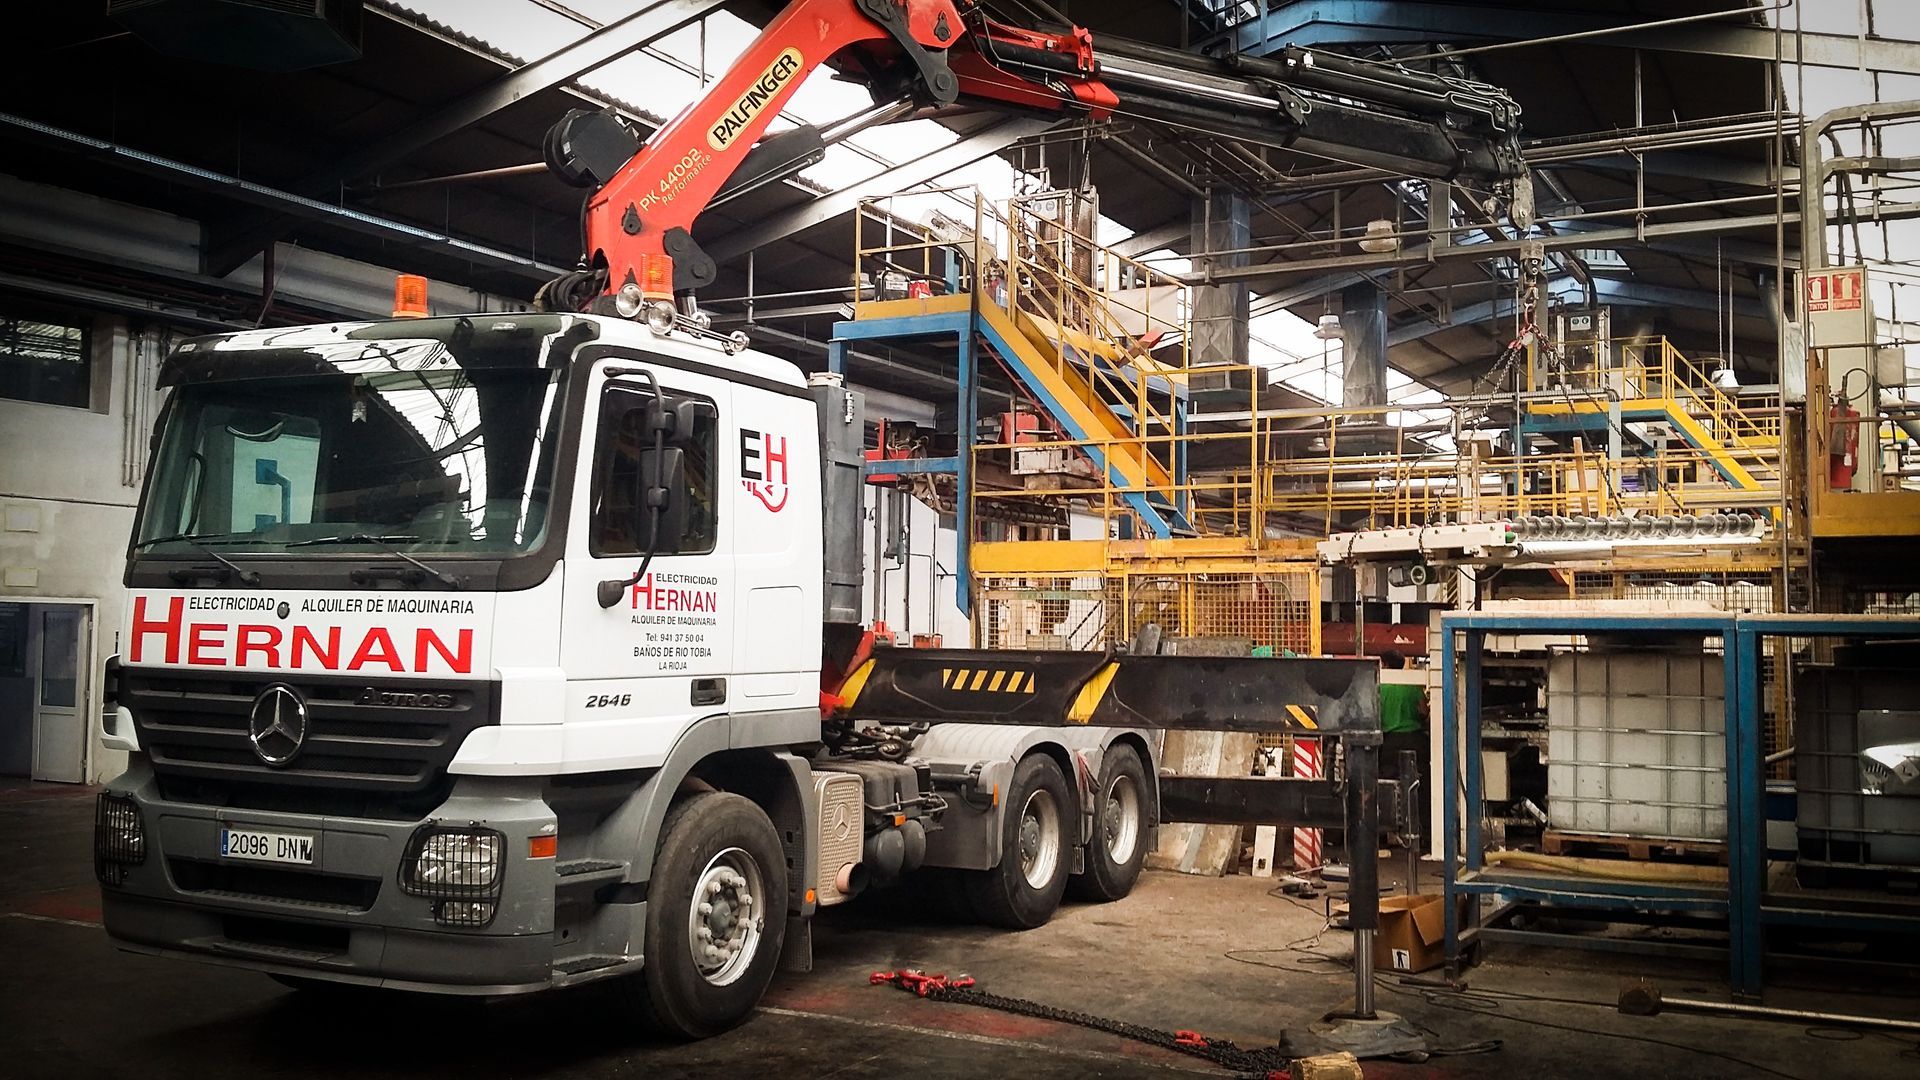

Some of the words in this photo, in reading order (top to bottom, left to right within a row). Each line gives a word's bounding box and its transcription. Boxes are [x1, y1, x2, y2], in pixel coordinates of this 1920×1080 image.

[712, 54, 798, 145] PALFINGER
[640, 189, 660, 211] PK
[660, 148, 702, 193] 44002
[740, 427, 788, 485] EH
[656, 573, 718, 586] ELECTRICIDAD
[632, 571, 717, 613] HERNAN
[189, 597, 275, 611] ELECTRICIDAD
[301, 599, 363, 613] ALQUILER
[366, 599, 384, 613] DE
[387, 599, 474, 614] MAQUINARIA
[631, 615, 666, 625] ALQUILER
[667, 616, 676, 625] DE
[678, 616, 717, 626] MAQUINARIA
[129, 596, 474, 674] HERNAN
[660, 633, 673, 642] 941
[675, 634, 684, 642] 37
[685, 634, 695, 643] 50
[696, 634, 704, 643] 04
[634, 645, 662, 657] BAÑOS
[664, 647, 674, 657] DE
[658, 661, 667, 670] LA
[668, 661, 687, 671] RIOJA
[585, 694, 632, 709] 2646
[230, 833, 268, 856] 2096
